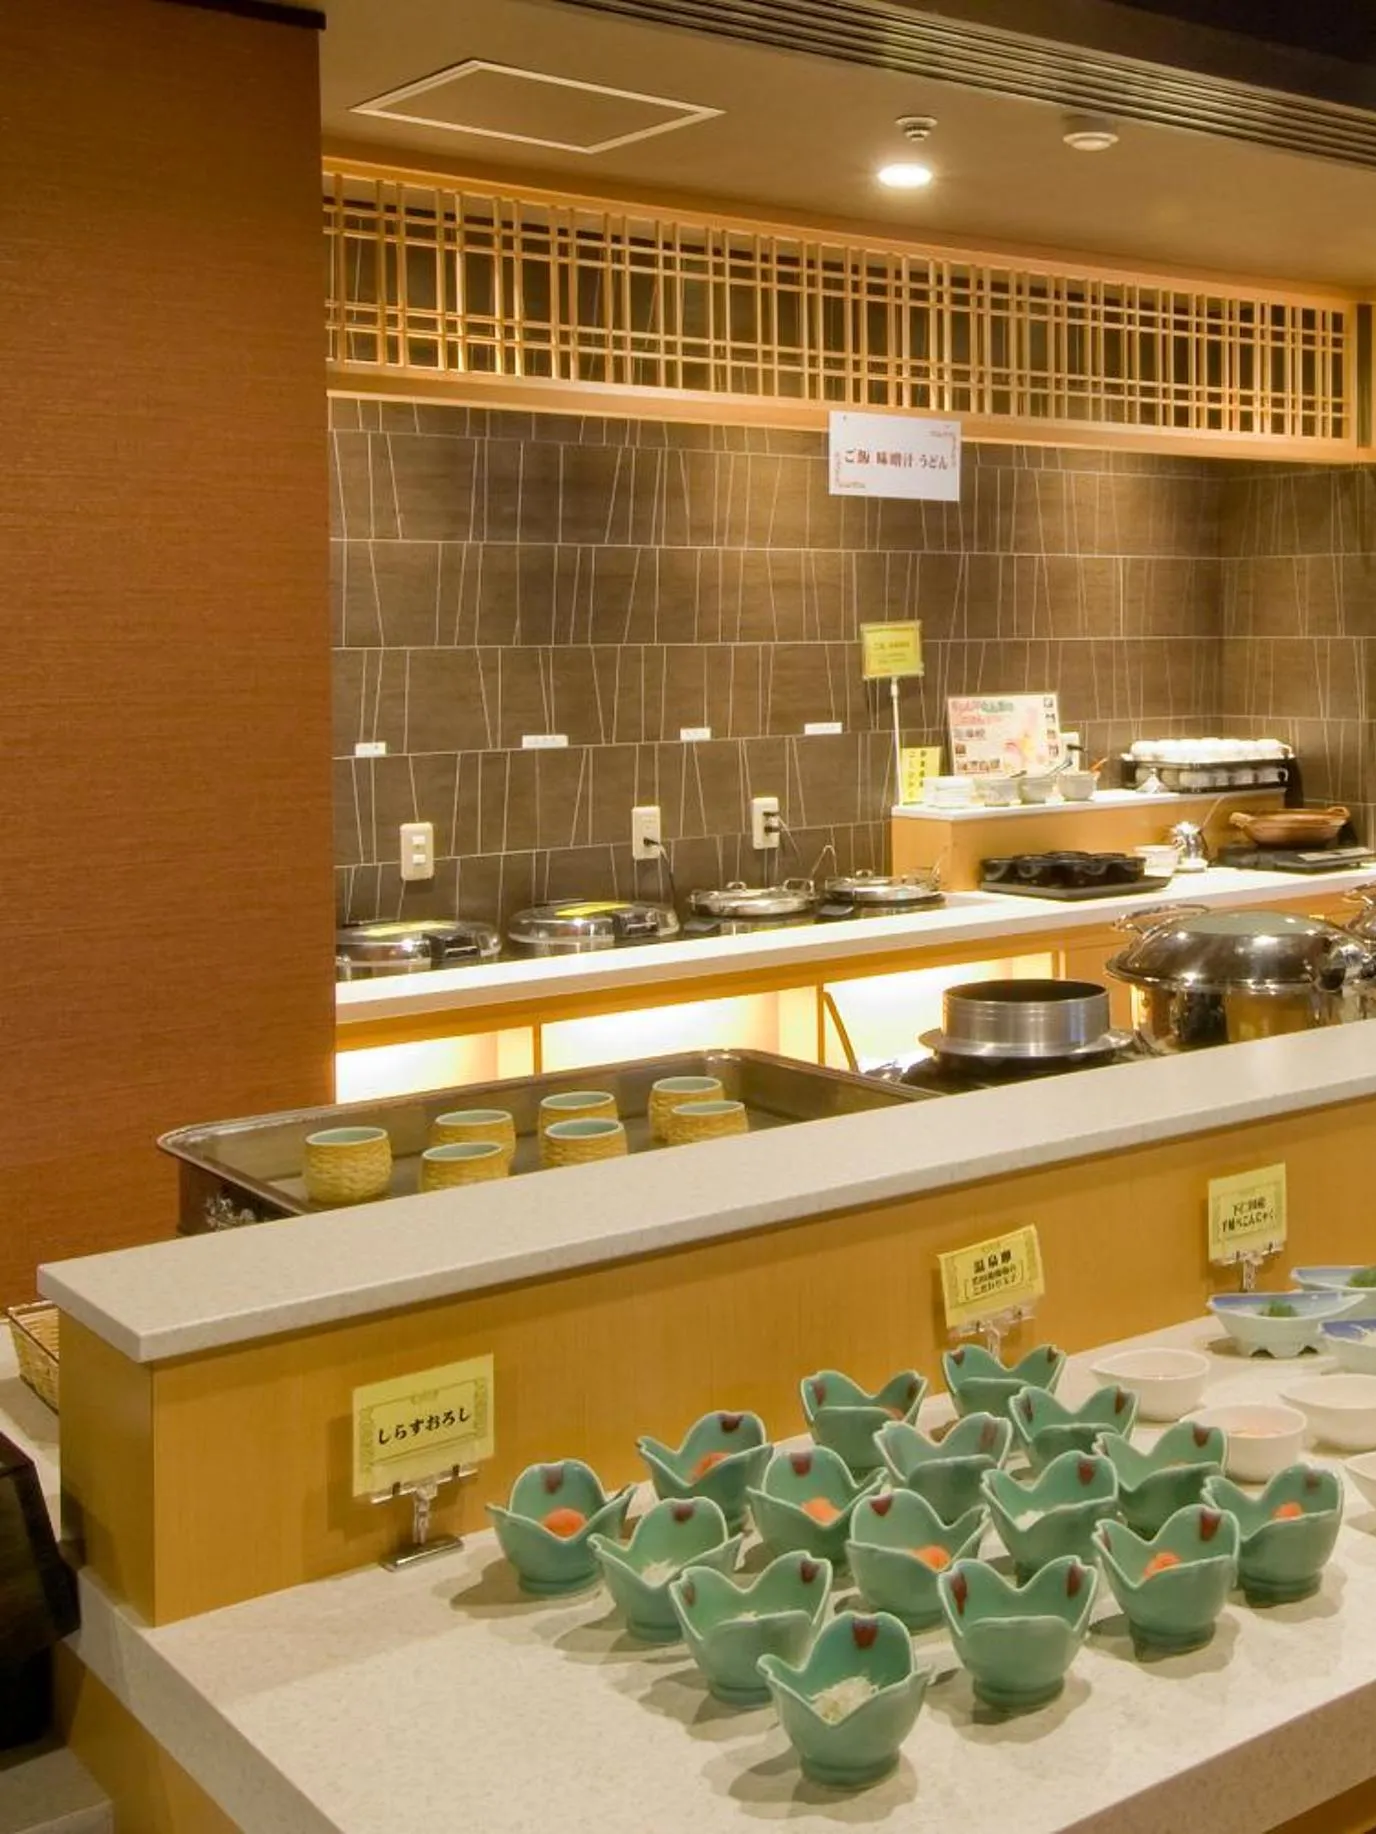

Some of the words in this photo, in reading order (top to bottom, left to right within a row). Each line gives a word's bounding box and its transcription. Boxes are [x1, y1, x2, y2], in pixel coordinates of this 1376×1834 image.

[919, 454, 949, 471] うどん
[378, 1407, 471, 1445] しらすおろし
